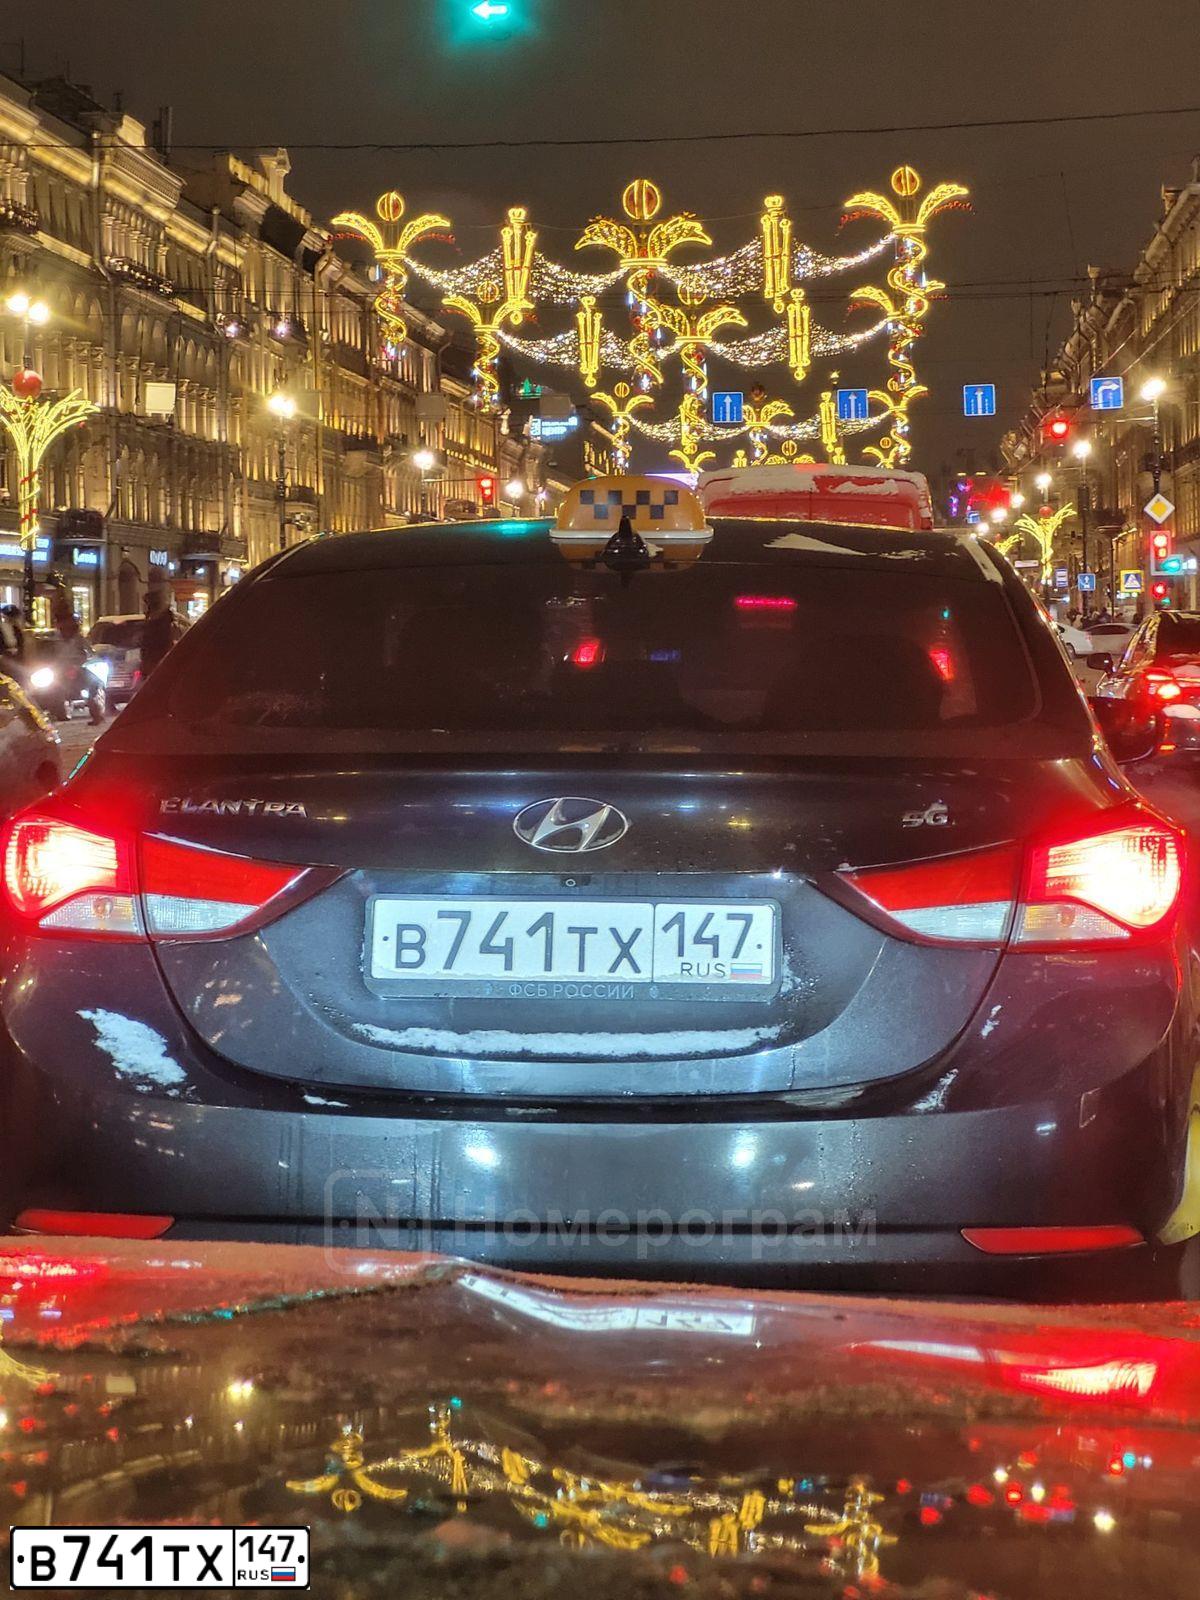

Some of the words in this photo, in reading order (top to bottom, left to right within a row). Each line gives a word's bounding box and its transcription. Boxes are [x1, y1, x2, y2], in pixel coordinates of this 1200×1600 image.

[160, 797, 308, 818] ELANTRA
[394, 910, 643, 974] В741ТХ
[661, 911, 754, 959] 147
[680, 962, 726, 978] RUS
[509, 983, 548, 998] ФСБ
[553, 983, 634, 999] РОССИИ
